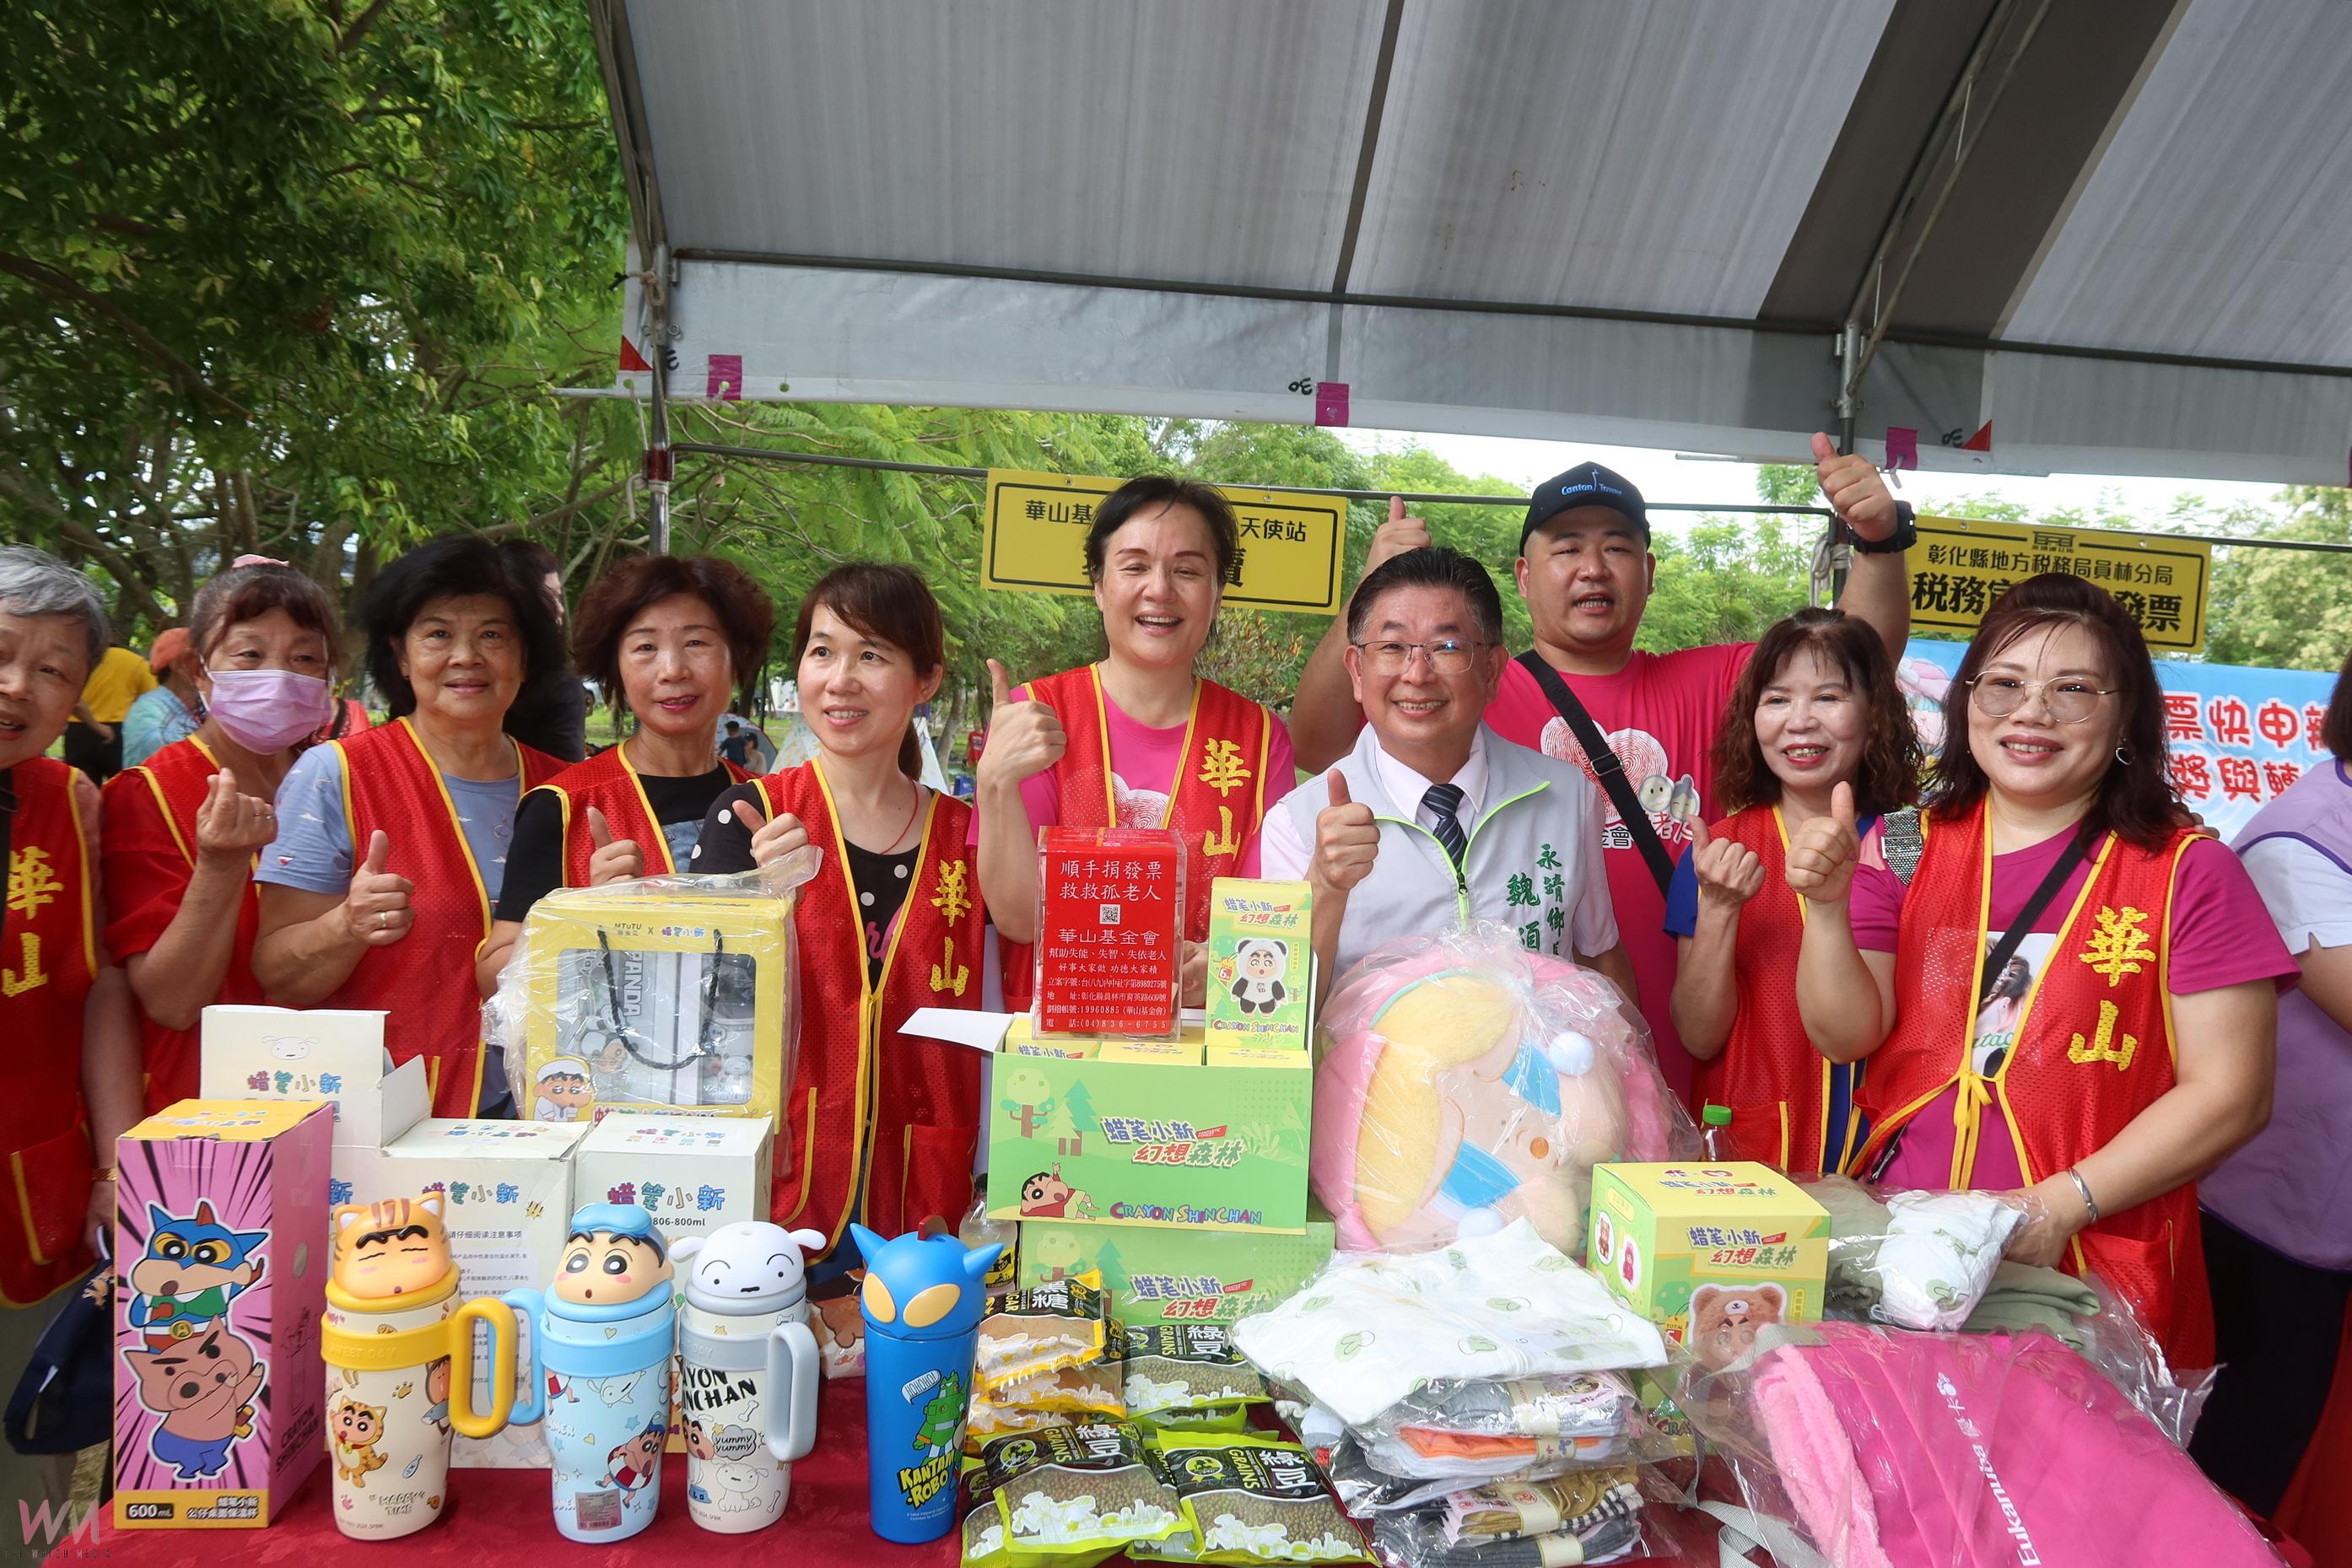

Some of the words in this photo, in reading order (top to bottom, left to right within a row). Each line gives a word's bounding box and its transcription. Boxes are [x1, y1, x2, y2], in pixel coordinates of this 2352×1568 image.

[1562, 483, 1594, 495] Canton
[1239, 516, 1308, 542] 天使站
[1197, 736, 1253, 862] 華山
[1060, 859, 1163, 881] 順手捐發票
[1060, 882, 1163, 902] 救救孤老人
[7, 845, 65, 997] 華山
[929, 859, 972, 998] 華山
[1239, 913, 1299, 927] 幻想森林
[1057, 928, 1161, 946] 華山基金會
[1058, 962, 1107, 973] 好事大家做
[2067, 905, 2157, 1072] 華山
[1103, 1118, 1195, 1141] 蜡笔小新
[1134, 1140, 1243, 1167] 幻想森林
[1110, 1201, 1174, 1222] CRAYON
[1689, 1226, 1761, 1247] 蜡笔小新
[1711, 1245, 1798, 1266] 幻想森林
[1134, 1275, 1223, 1297] 蜡笔小新
[1159, 1325, 1178, 1355] GRAINS
[715, 1434, 753, 1445] yummy
[715, 1442, 753, 1453] yummy
[1044, 1428, 1072, 1463] GRAINS
[898, 1449, 955, 1492] KANTAM
[1228, 1448, 1260, 1490] GRAINS
[1972, 1443, 2042, 1566] Eukanuba
